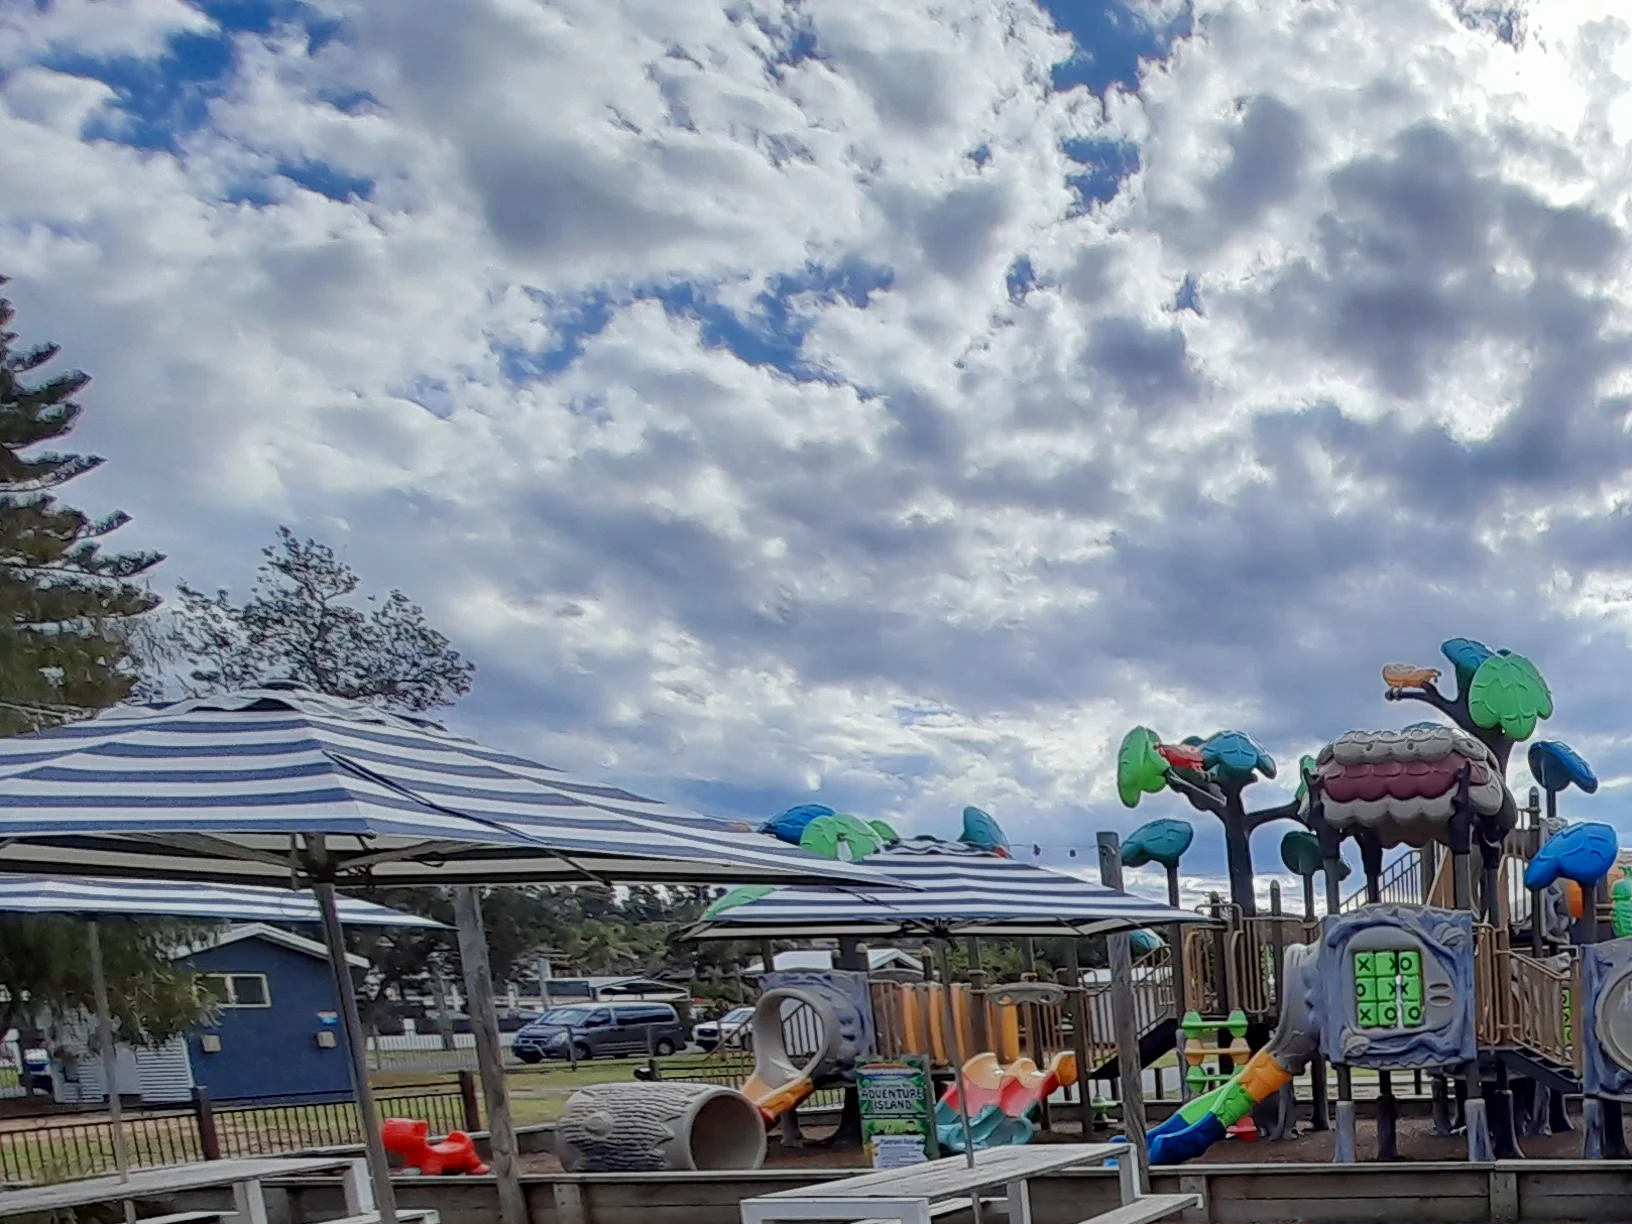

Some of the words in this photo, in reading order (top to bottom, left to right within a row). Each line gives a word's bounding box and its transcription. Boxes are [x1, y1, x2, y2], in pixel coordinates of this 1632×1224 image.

[1357, 957, 1371, 971] X
[1360, 1008, 1372, 1021] X
[861, 1088, 924, 1099] ADVENTURE
[875, 1100, 912, 1110] ISLAND
